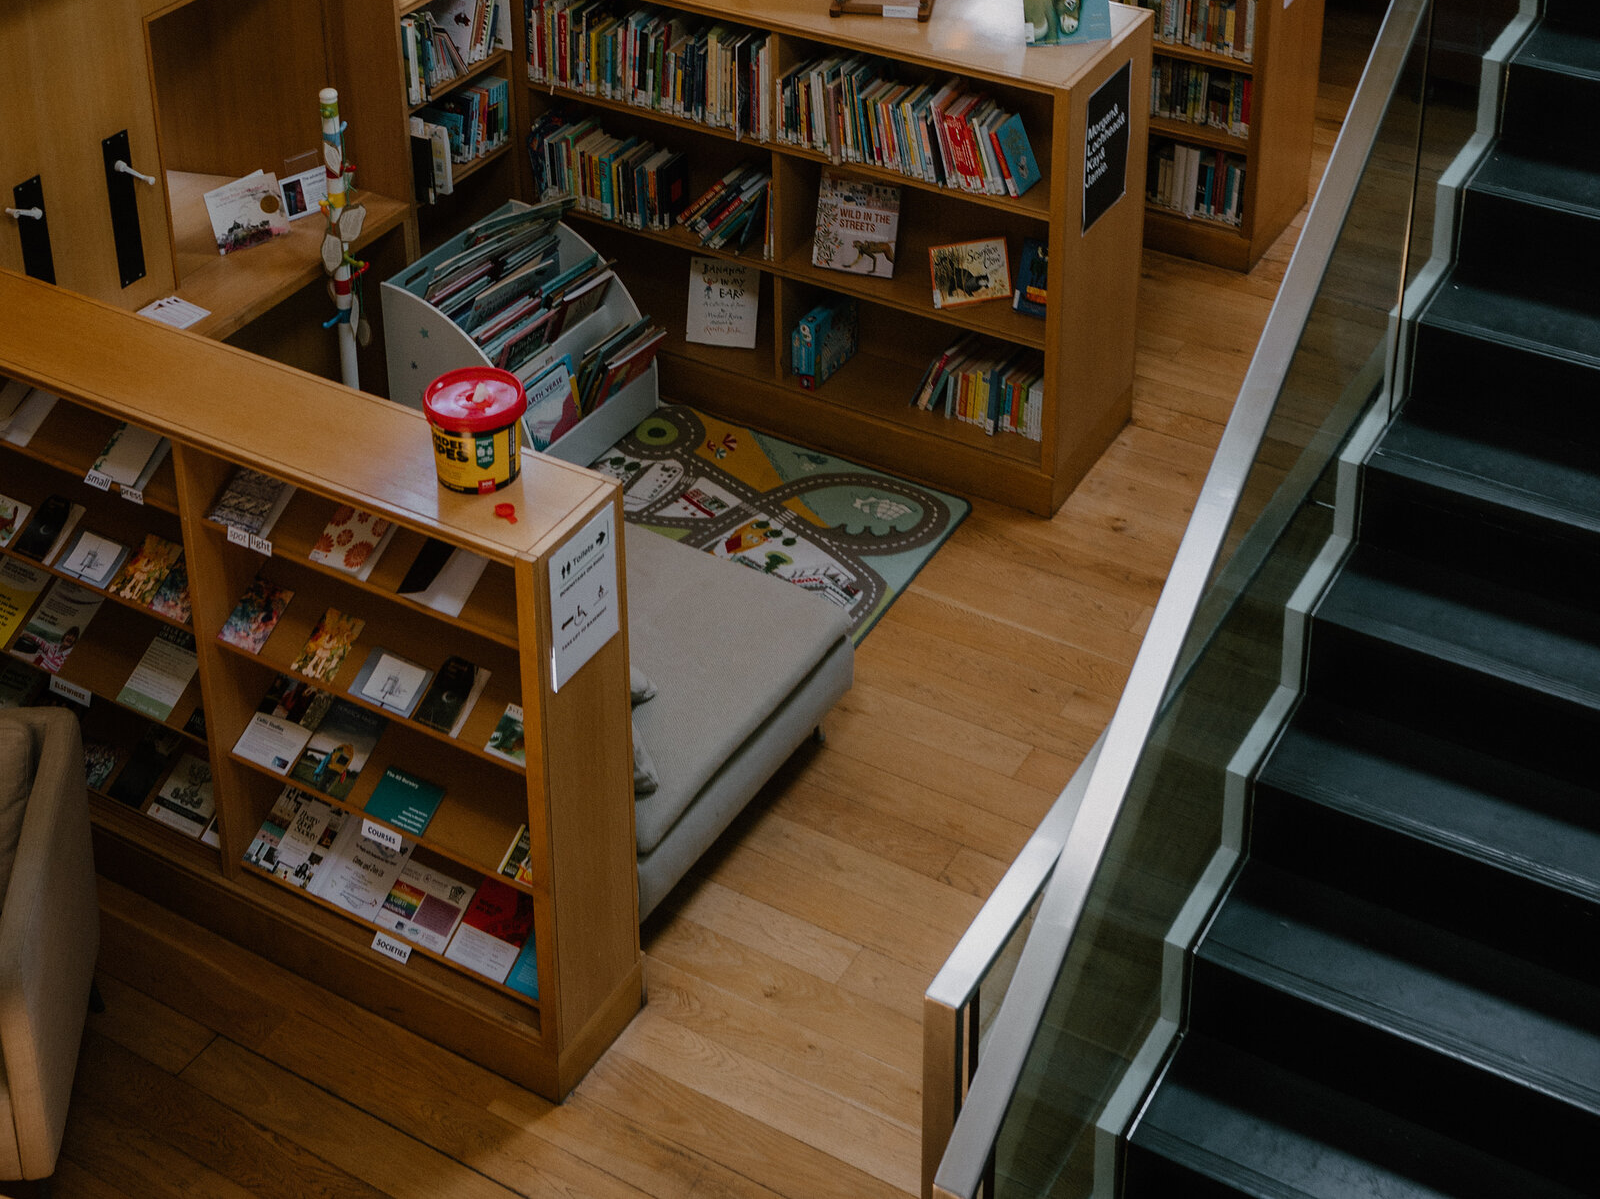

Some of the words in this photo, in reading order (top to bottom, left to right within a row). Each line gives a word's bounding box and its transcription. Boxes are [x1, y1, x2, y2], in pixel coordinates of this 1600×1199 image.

[840, 208, 862, 220] WILD
[863, 212, 872, 222] IN
[874, 213, 892, 225] THE
[840, 219, 876, 233] STREETS
[702, 263, 746, 276] BANANAS
[720, 288, 745, 300] EARS
[527, 389, 544, 406] ARTH
[545, 376, 563, 392] VERSE
[88, 473, 110, 489] small
[120, 488, 143, 502] press
[230, 531, 247, 544] spot
[251, 534, 271, 554] light
[572, 543, 594, 567] Toilets
[54, 681, 86, 700] ELSEWHERE
[367, 826, 396, 845] COURSES
[376, 938, 407, 959] SOCIETIES
